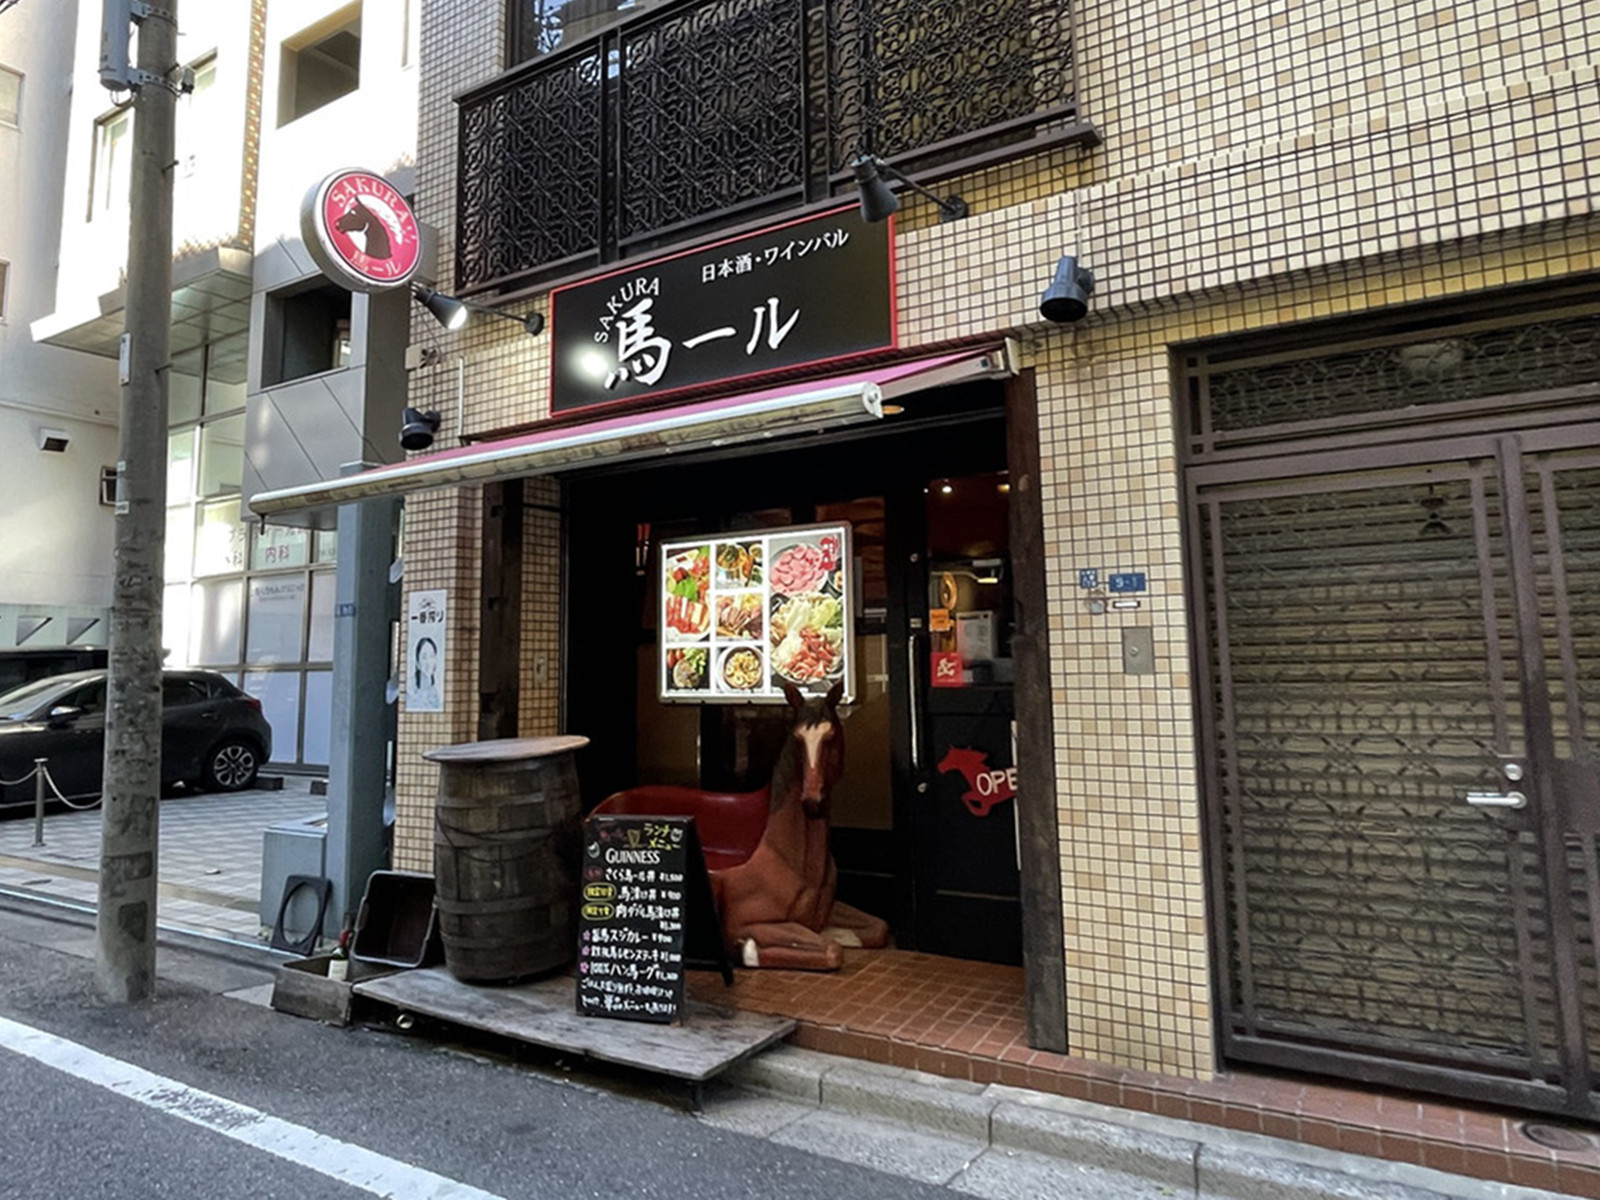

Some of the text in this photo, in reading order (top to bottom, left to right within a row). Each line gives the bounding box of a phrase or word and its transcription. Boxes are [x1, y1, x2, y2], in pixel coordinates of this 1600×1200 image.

[331, 178, 409, 223] SAKURA
[701, 228, 849, 284] 日本酒・ワインバル
[594, 276, 660, 343] SAKURA
[603, 297, 800, 390] 馬ール
[976, 767, 1018, 796] OPE
[605, 847, 661, 864] GUINNESS
